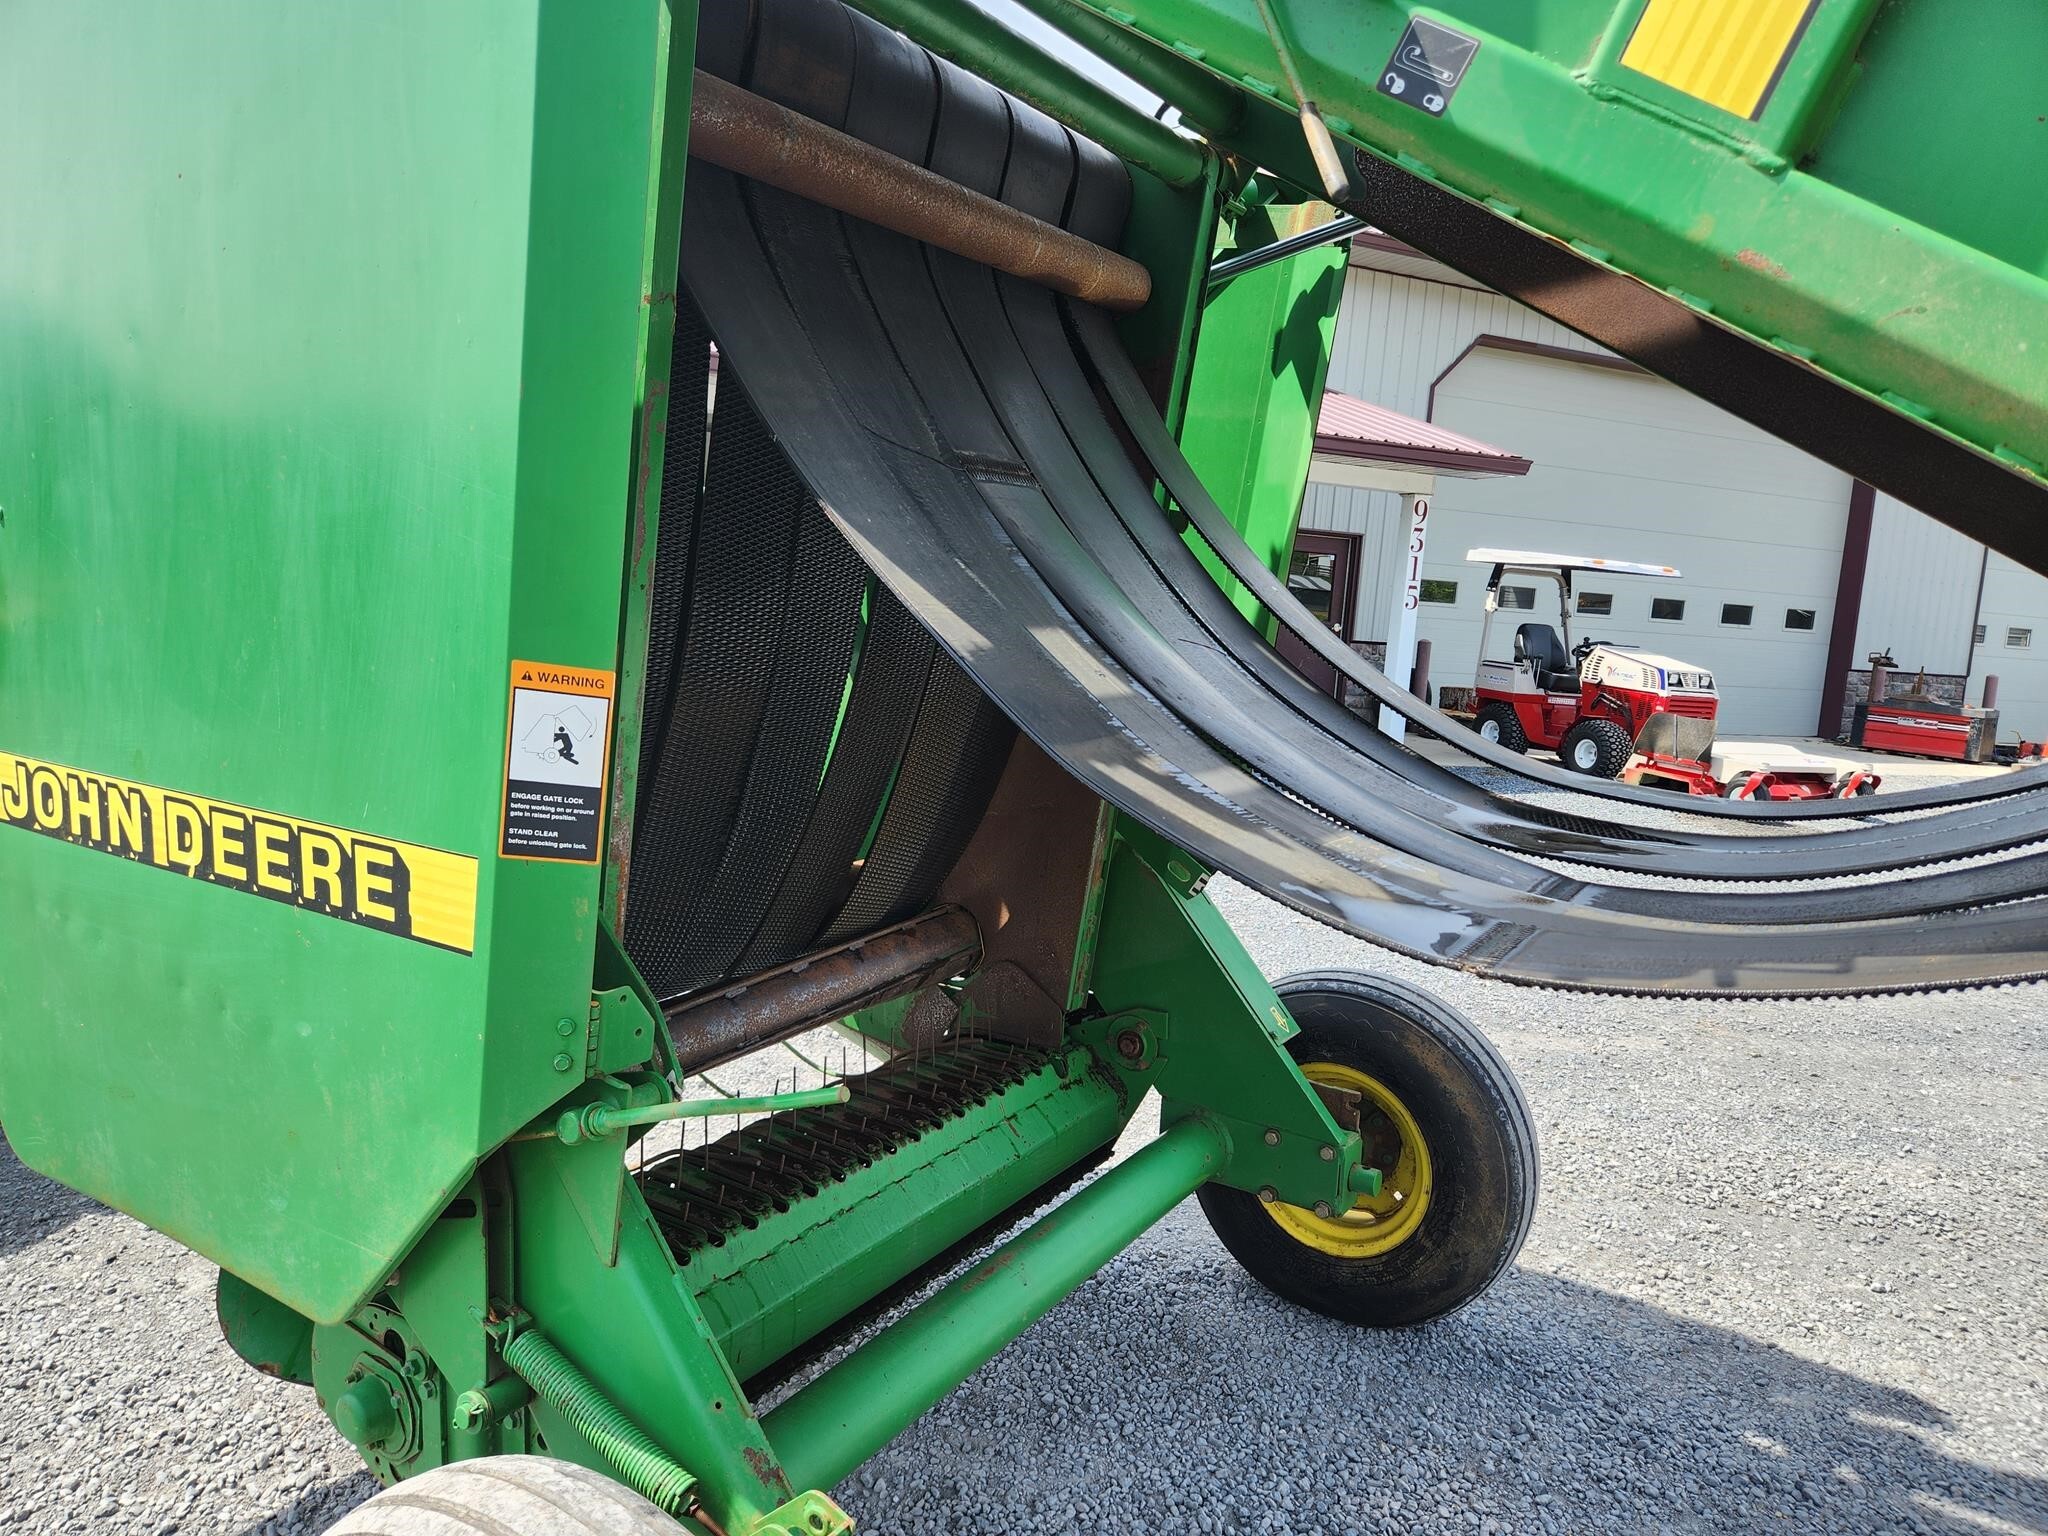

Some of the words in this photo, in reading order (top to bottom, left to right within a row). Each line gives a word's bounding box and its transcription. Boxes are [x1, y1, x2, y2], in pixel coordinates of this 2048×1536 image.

[1404, 499, 1429, 611] 9315
[537, 671, 605, 690] WARNING
[511, 792, 542, 801] ENGAGE
[542, 795, 563, 803] GATE
[564, 796, 584, 805] LOCK
[510, 802, 530, 810] before
[530, 804, 556, 813] working
[573, 808, 595, 816] around
[531, 812, 551, 820] raised
[551, 814, 578, 822] position.
[508, 828, 533, 836] STAND
[534, 830, 559, 838] CLEAR
[2, 760, 143, 853] JOHN
[164, 796, 397, 923] DEERE
[528, 840, 558, 849] unlocking
